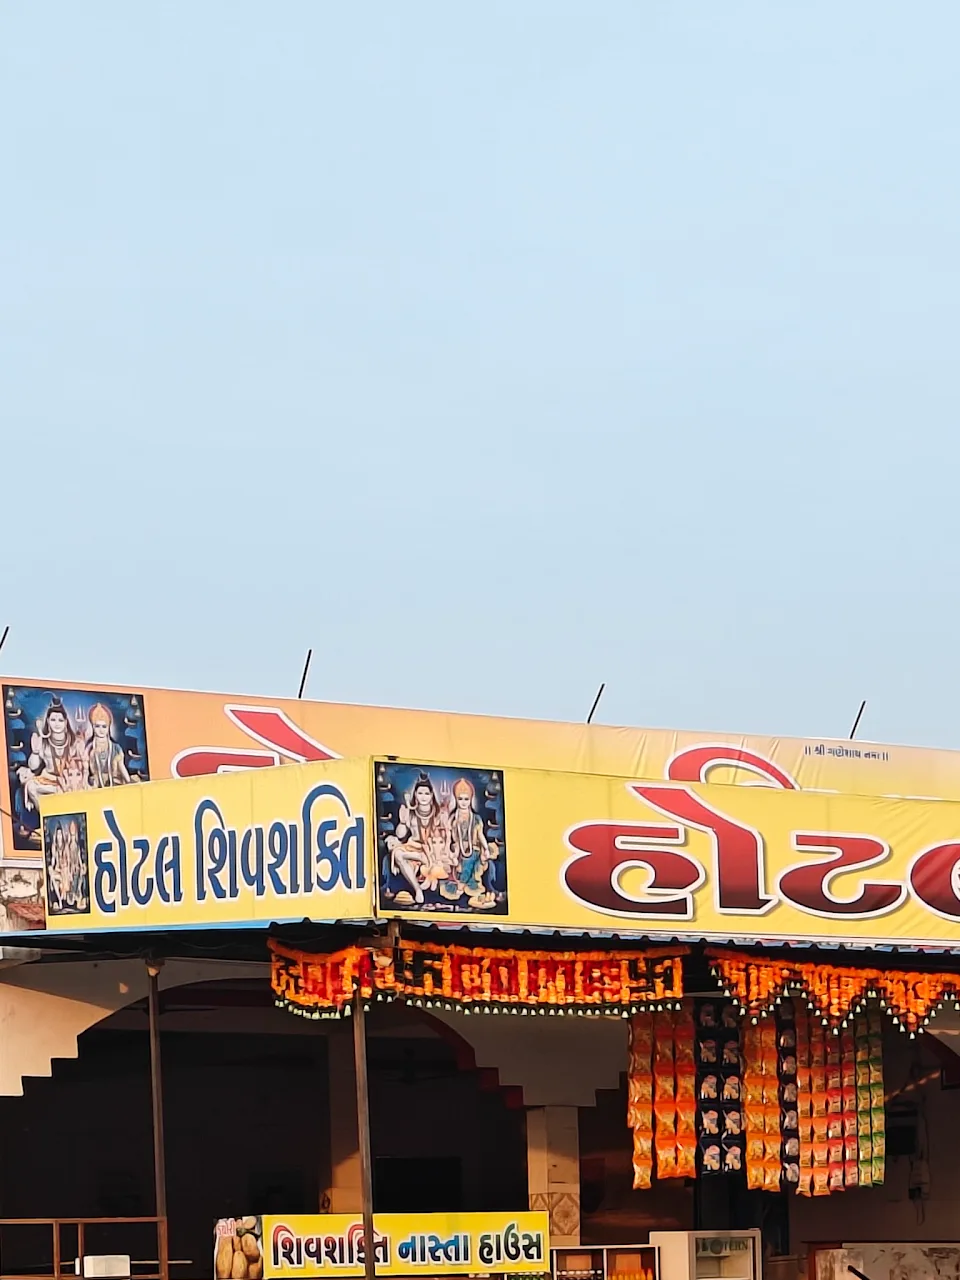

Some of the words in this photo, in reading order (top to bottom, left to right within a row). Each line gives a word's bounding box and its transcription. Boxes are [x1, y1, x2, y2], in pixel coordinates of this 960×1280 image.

[94, 809, 182, 913] હોટલ
[194, 784, 366, 901] શિવશક્તિ
[397, 1234, 470, 1264] નાસ્તા
[479, 1222, 542, 1265] હાઉસ
